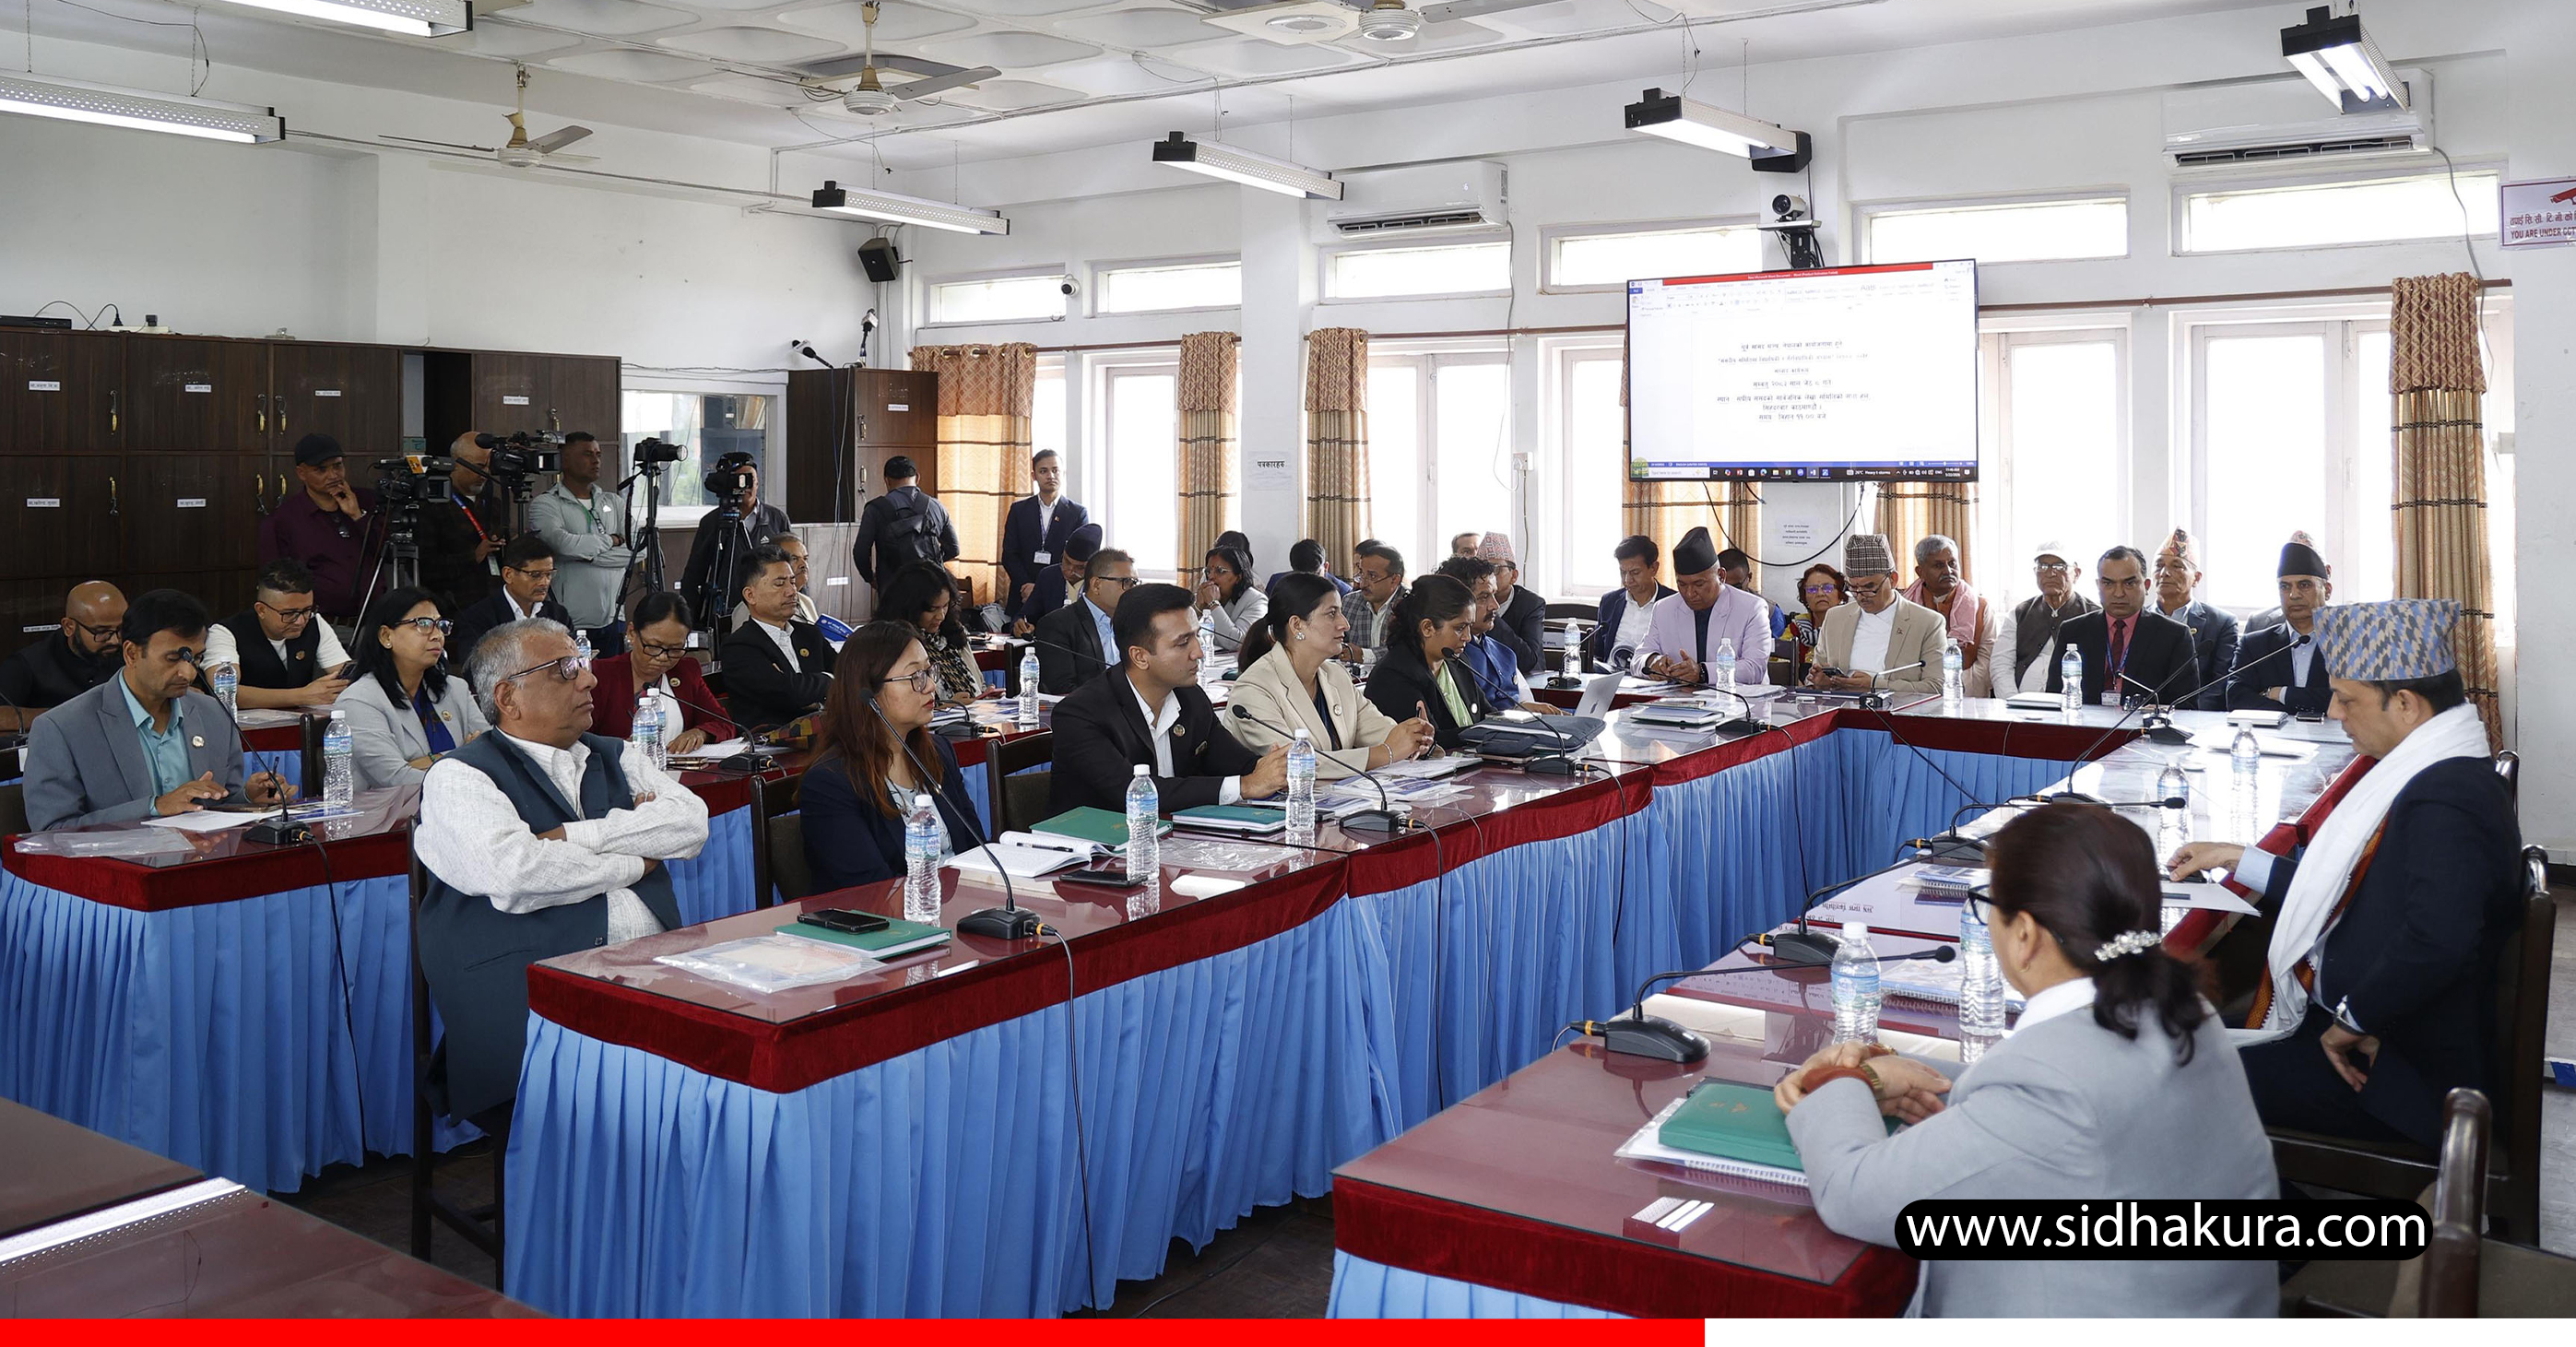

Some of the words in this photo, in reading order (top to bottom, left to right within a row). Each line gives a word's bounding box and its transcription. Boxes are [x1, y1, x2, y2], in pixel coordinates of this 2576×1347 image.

[2511, 230, 2524, 239] YOU
[2525, 229, 2538, 238] ARE
[2540, 227, 2562, 237] UNDER
